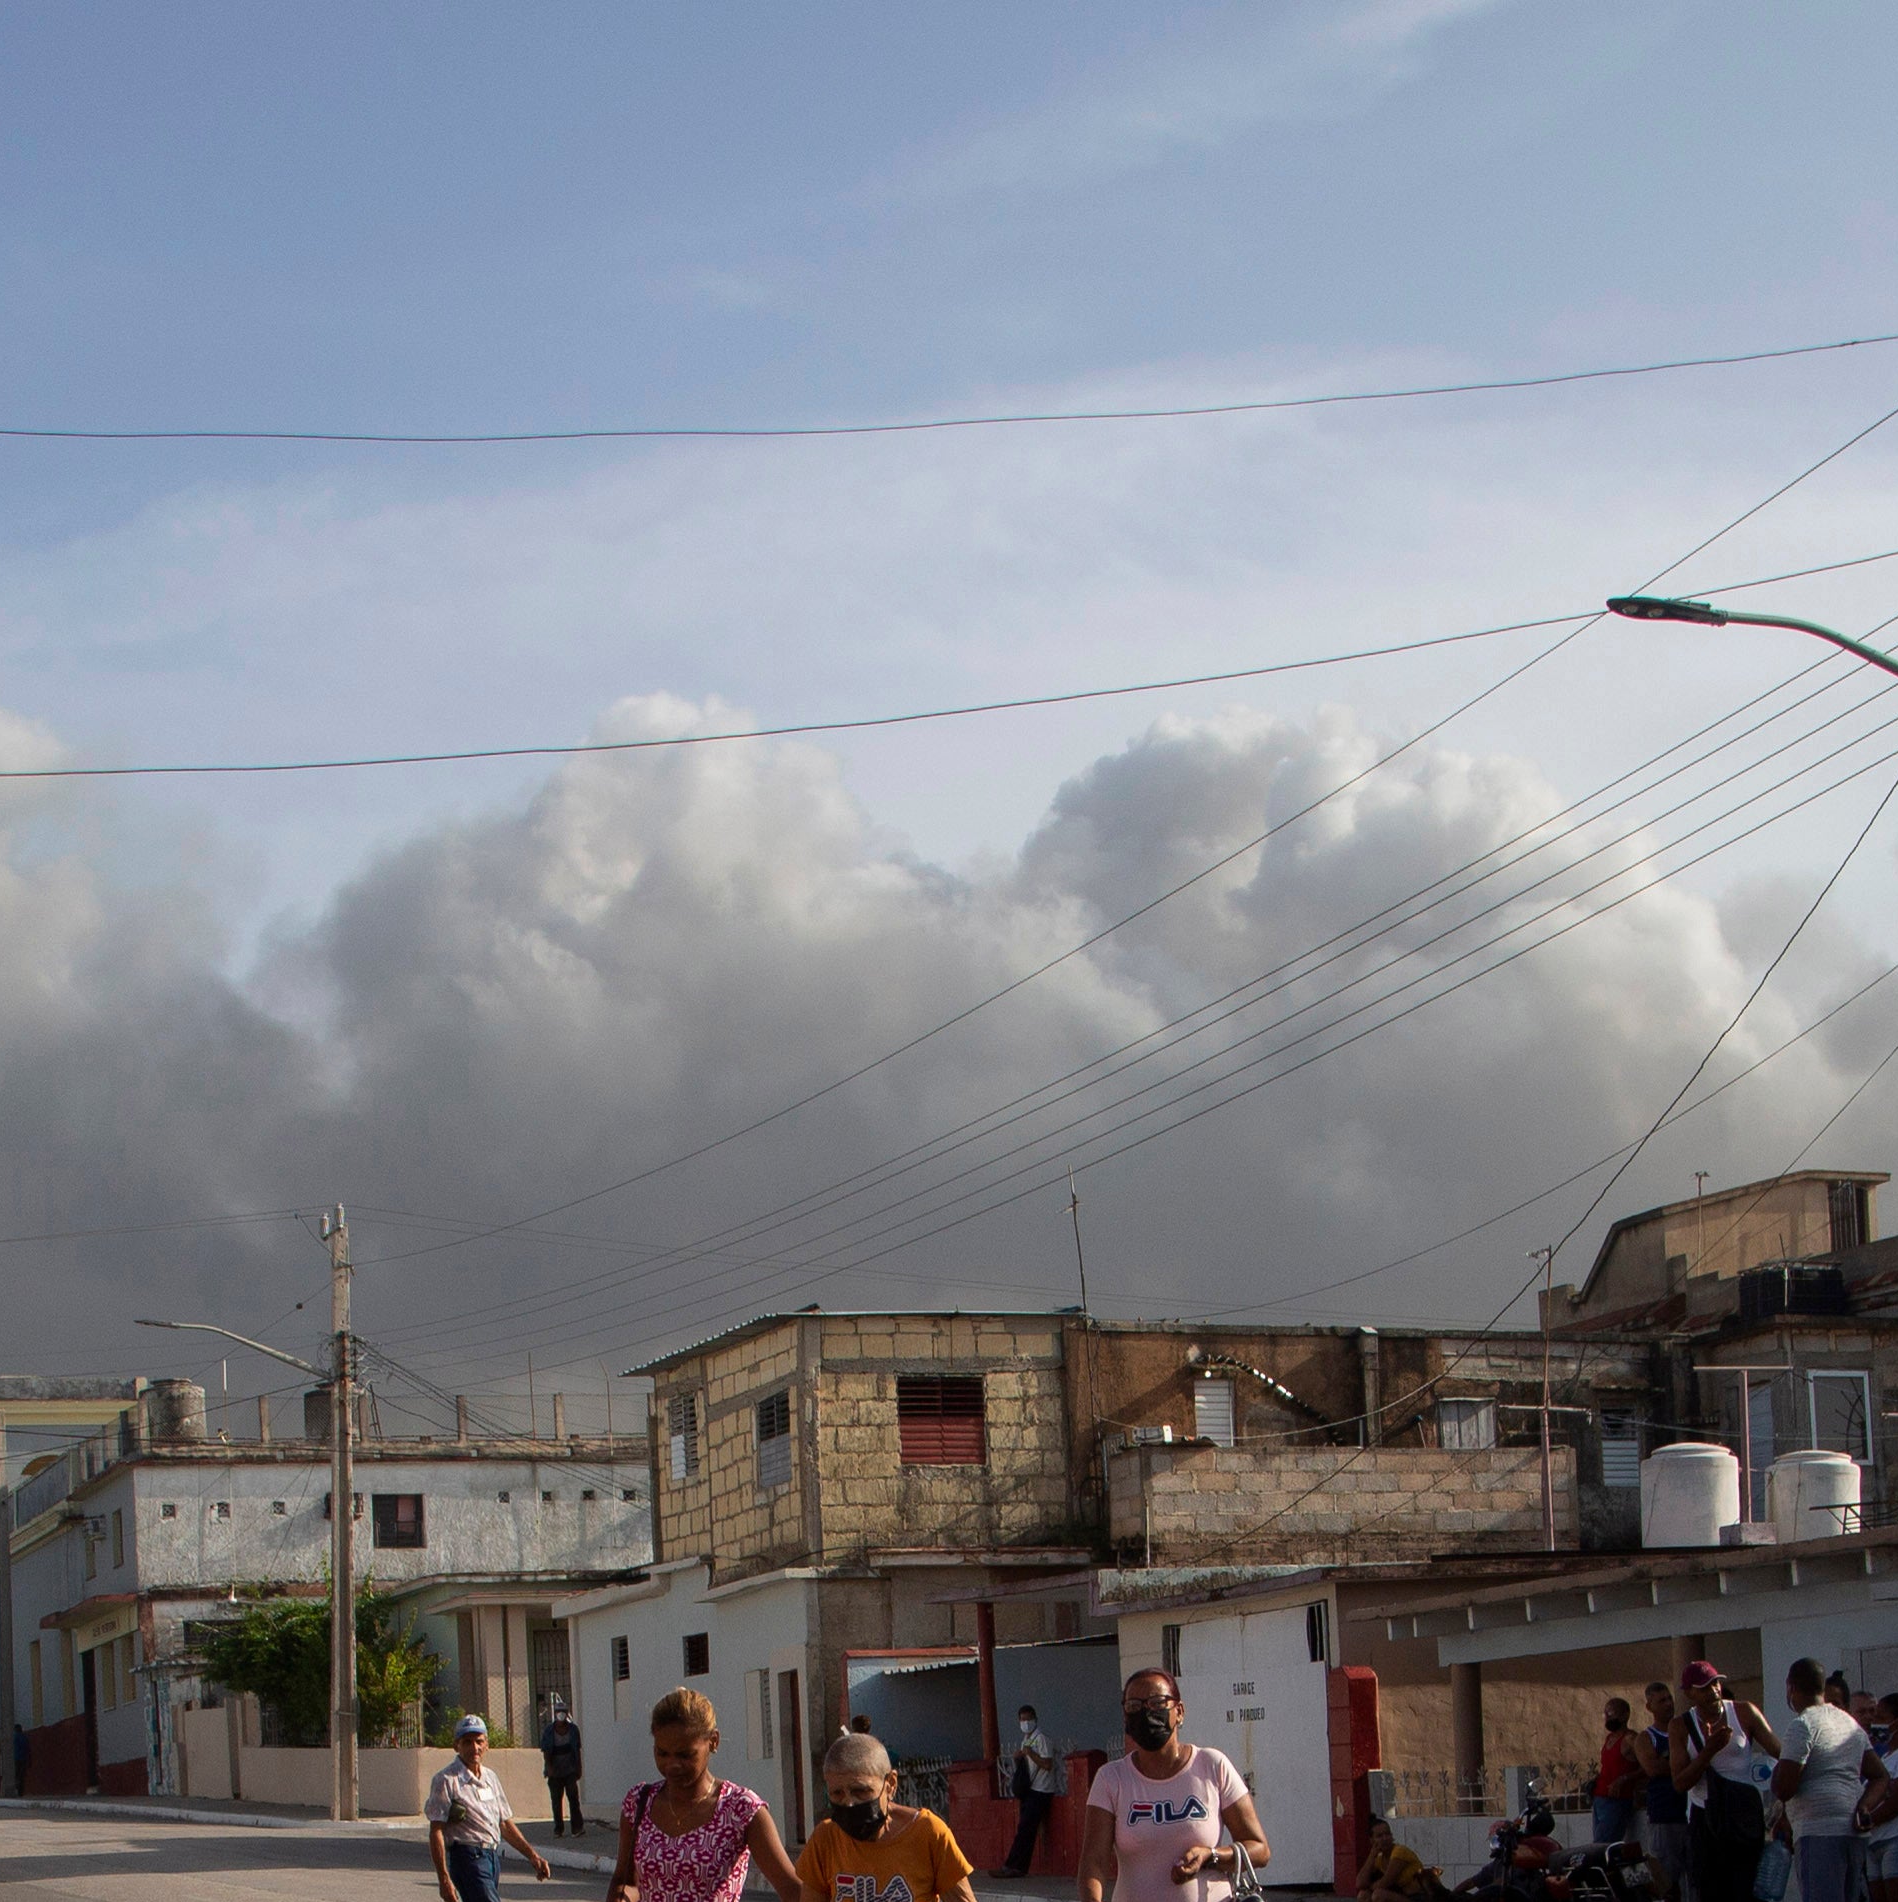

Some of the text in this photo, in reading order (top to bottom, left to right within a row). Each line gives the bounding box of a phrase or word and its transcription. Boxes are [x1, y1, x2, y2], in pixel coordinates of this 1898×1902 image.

[1226, 1707, 1265, 1722] NO PARQUEO
[1127, 1795, 1209, 1827] FILA
